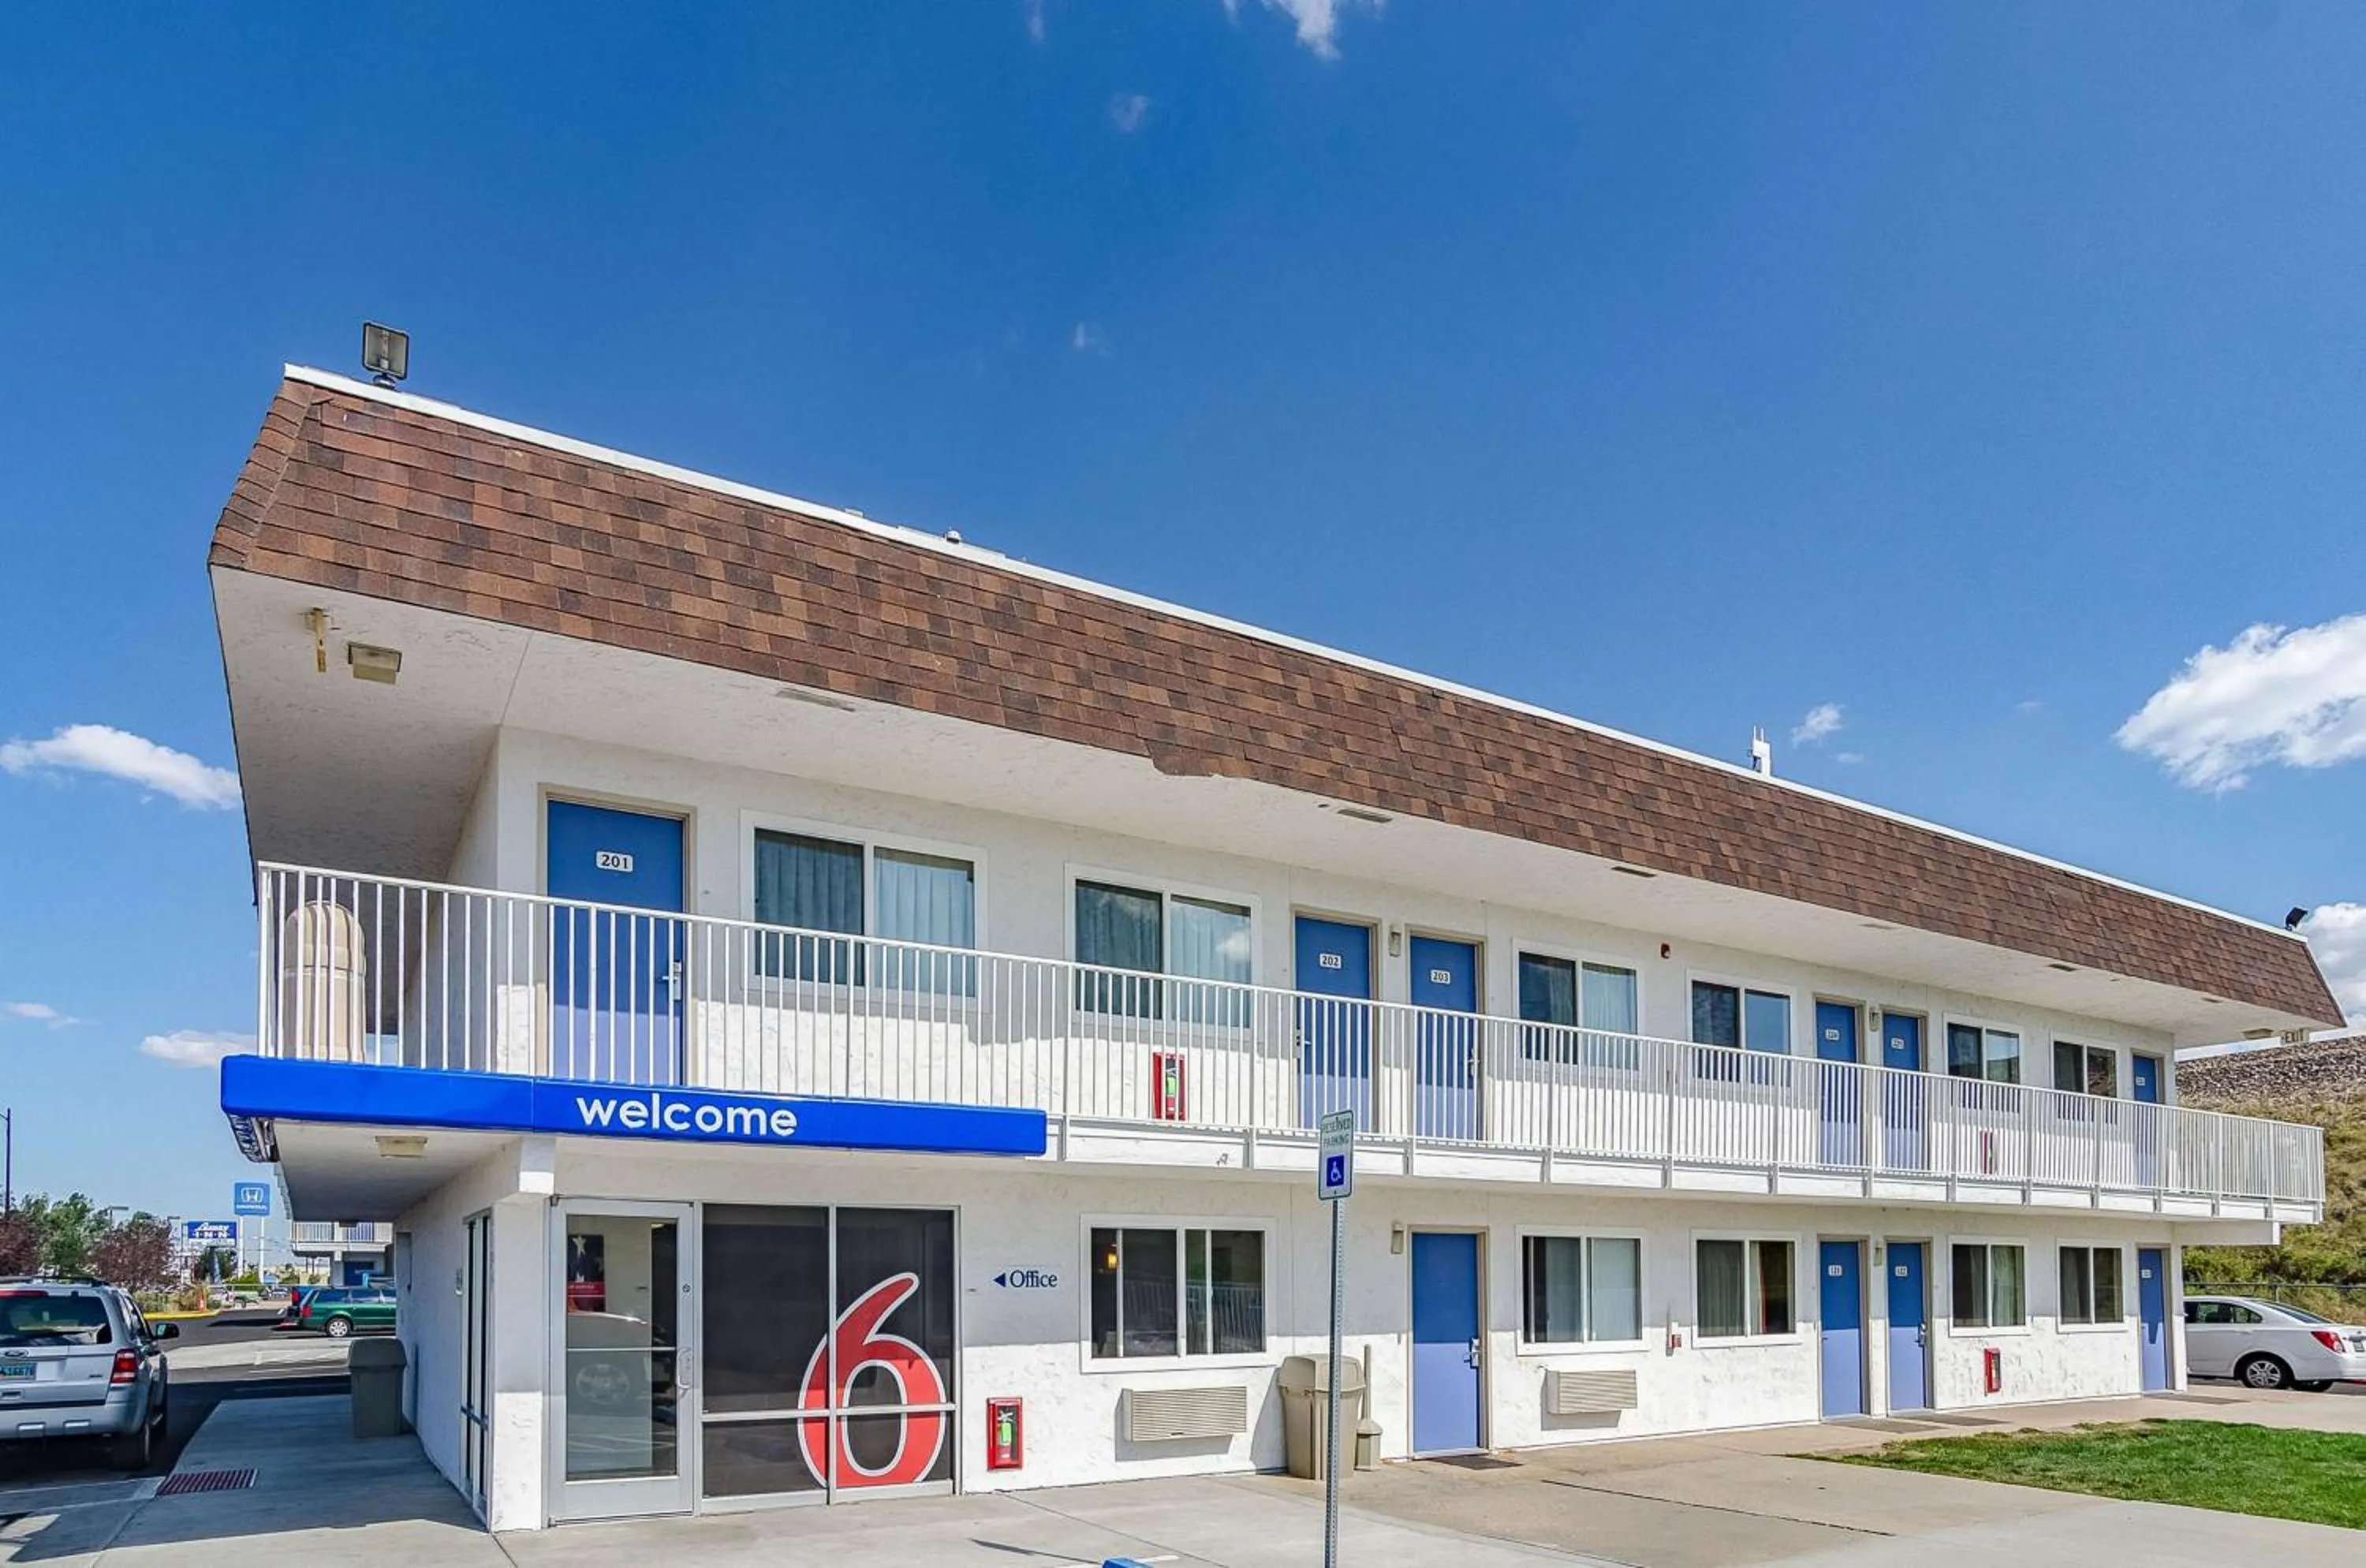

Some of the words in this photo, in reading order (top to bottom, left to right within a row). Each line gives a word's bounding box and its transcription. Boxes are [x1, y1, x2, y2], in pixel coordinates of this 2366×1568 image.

[602, 854, 628, 869] 201
[1322, 955, 1339, 966] 202
[576, 1092, 797, 1137] welcome
[1010, 1269, 1058, 1288] Office
[797, 1271, 946, 1490] 6
